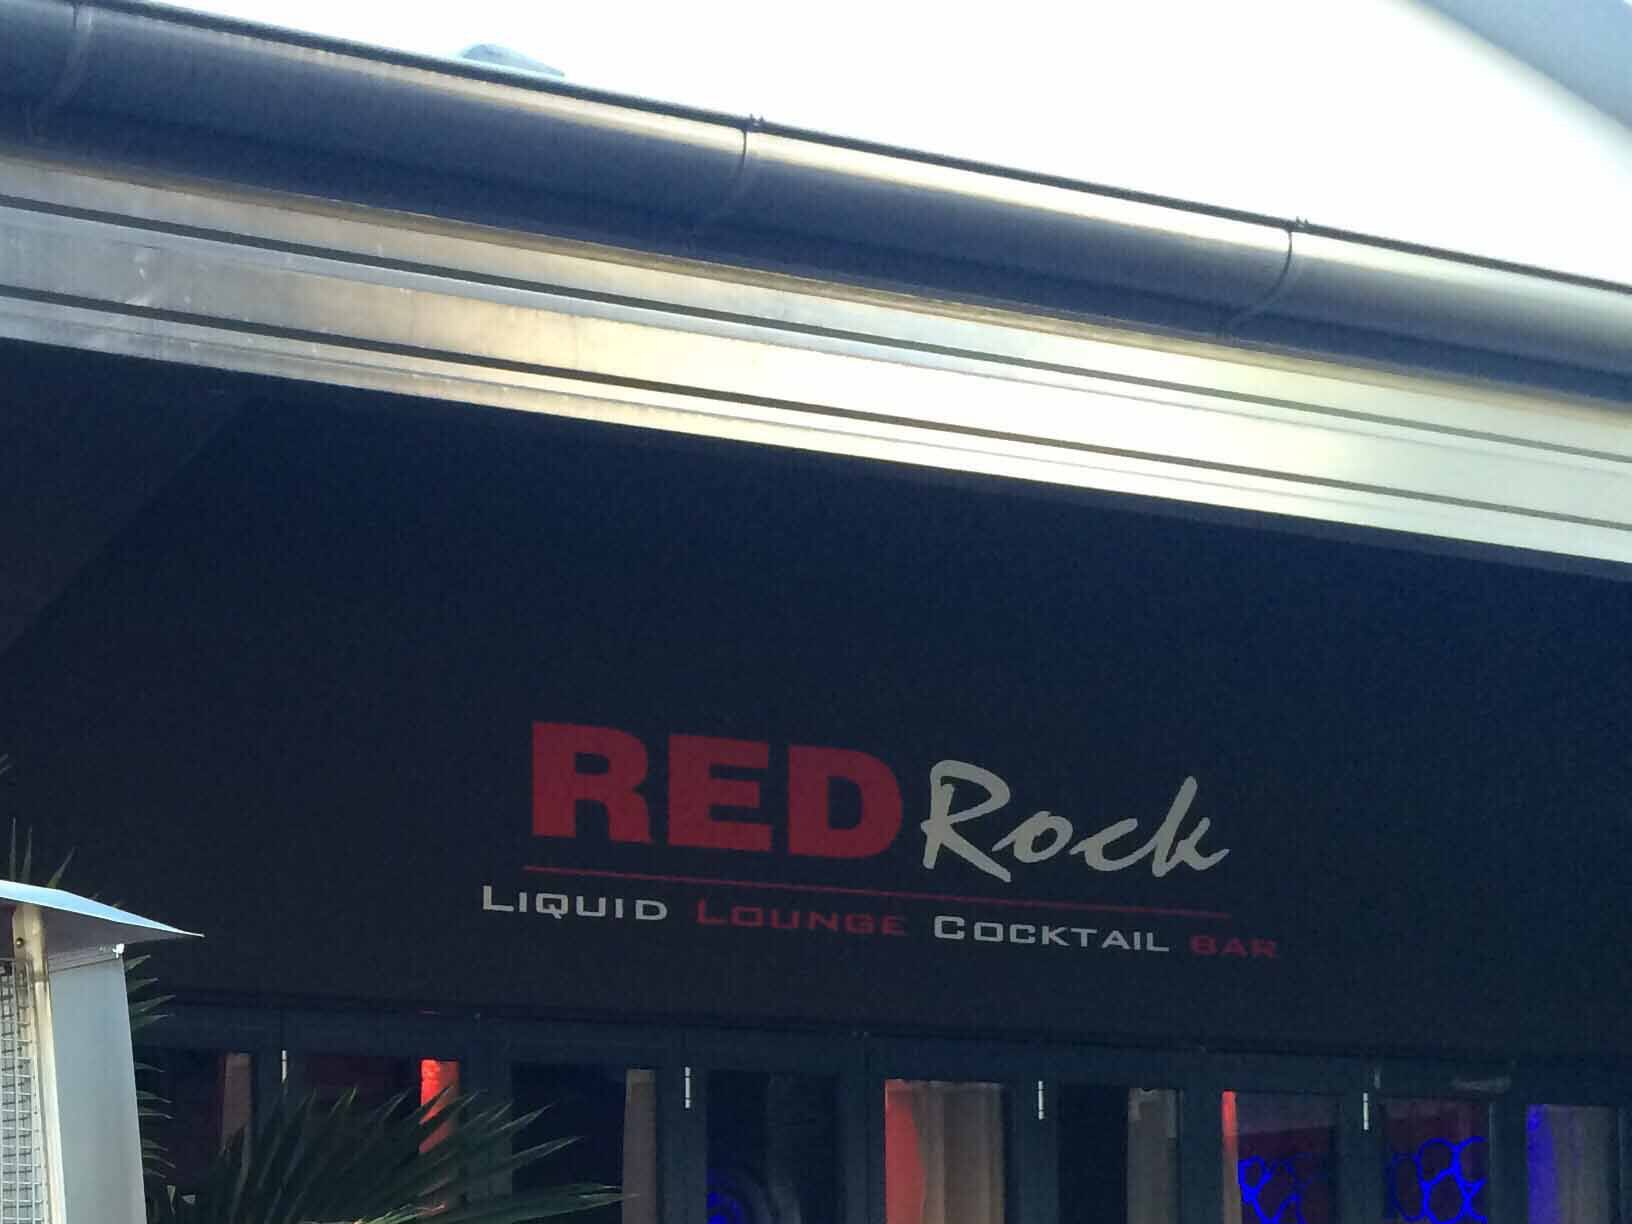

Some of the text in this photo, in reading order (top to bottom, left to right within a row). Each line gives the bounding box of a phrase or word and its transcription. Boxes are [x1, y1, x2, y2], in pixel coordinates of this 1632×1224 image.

[532, 721, 1230, 882] RED Rock
[482, 884, 1279, 959] LIQUID LOUNGE COCKTAIL BAR
